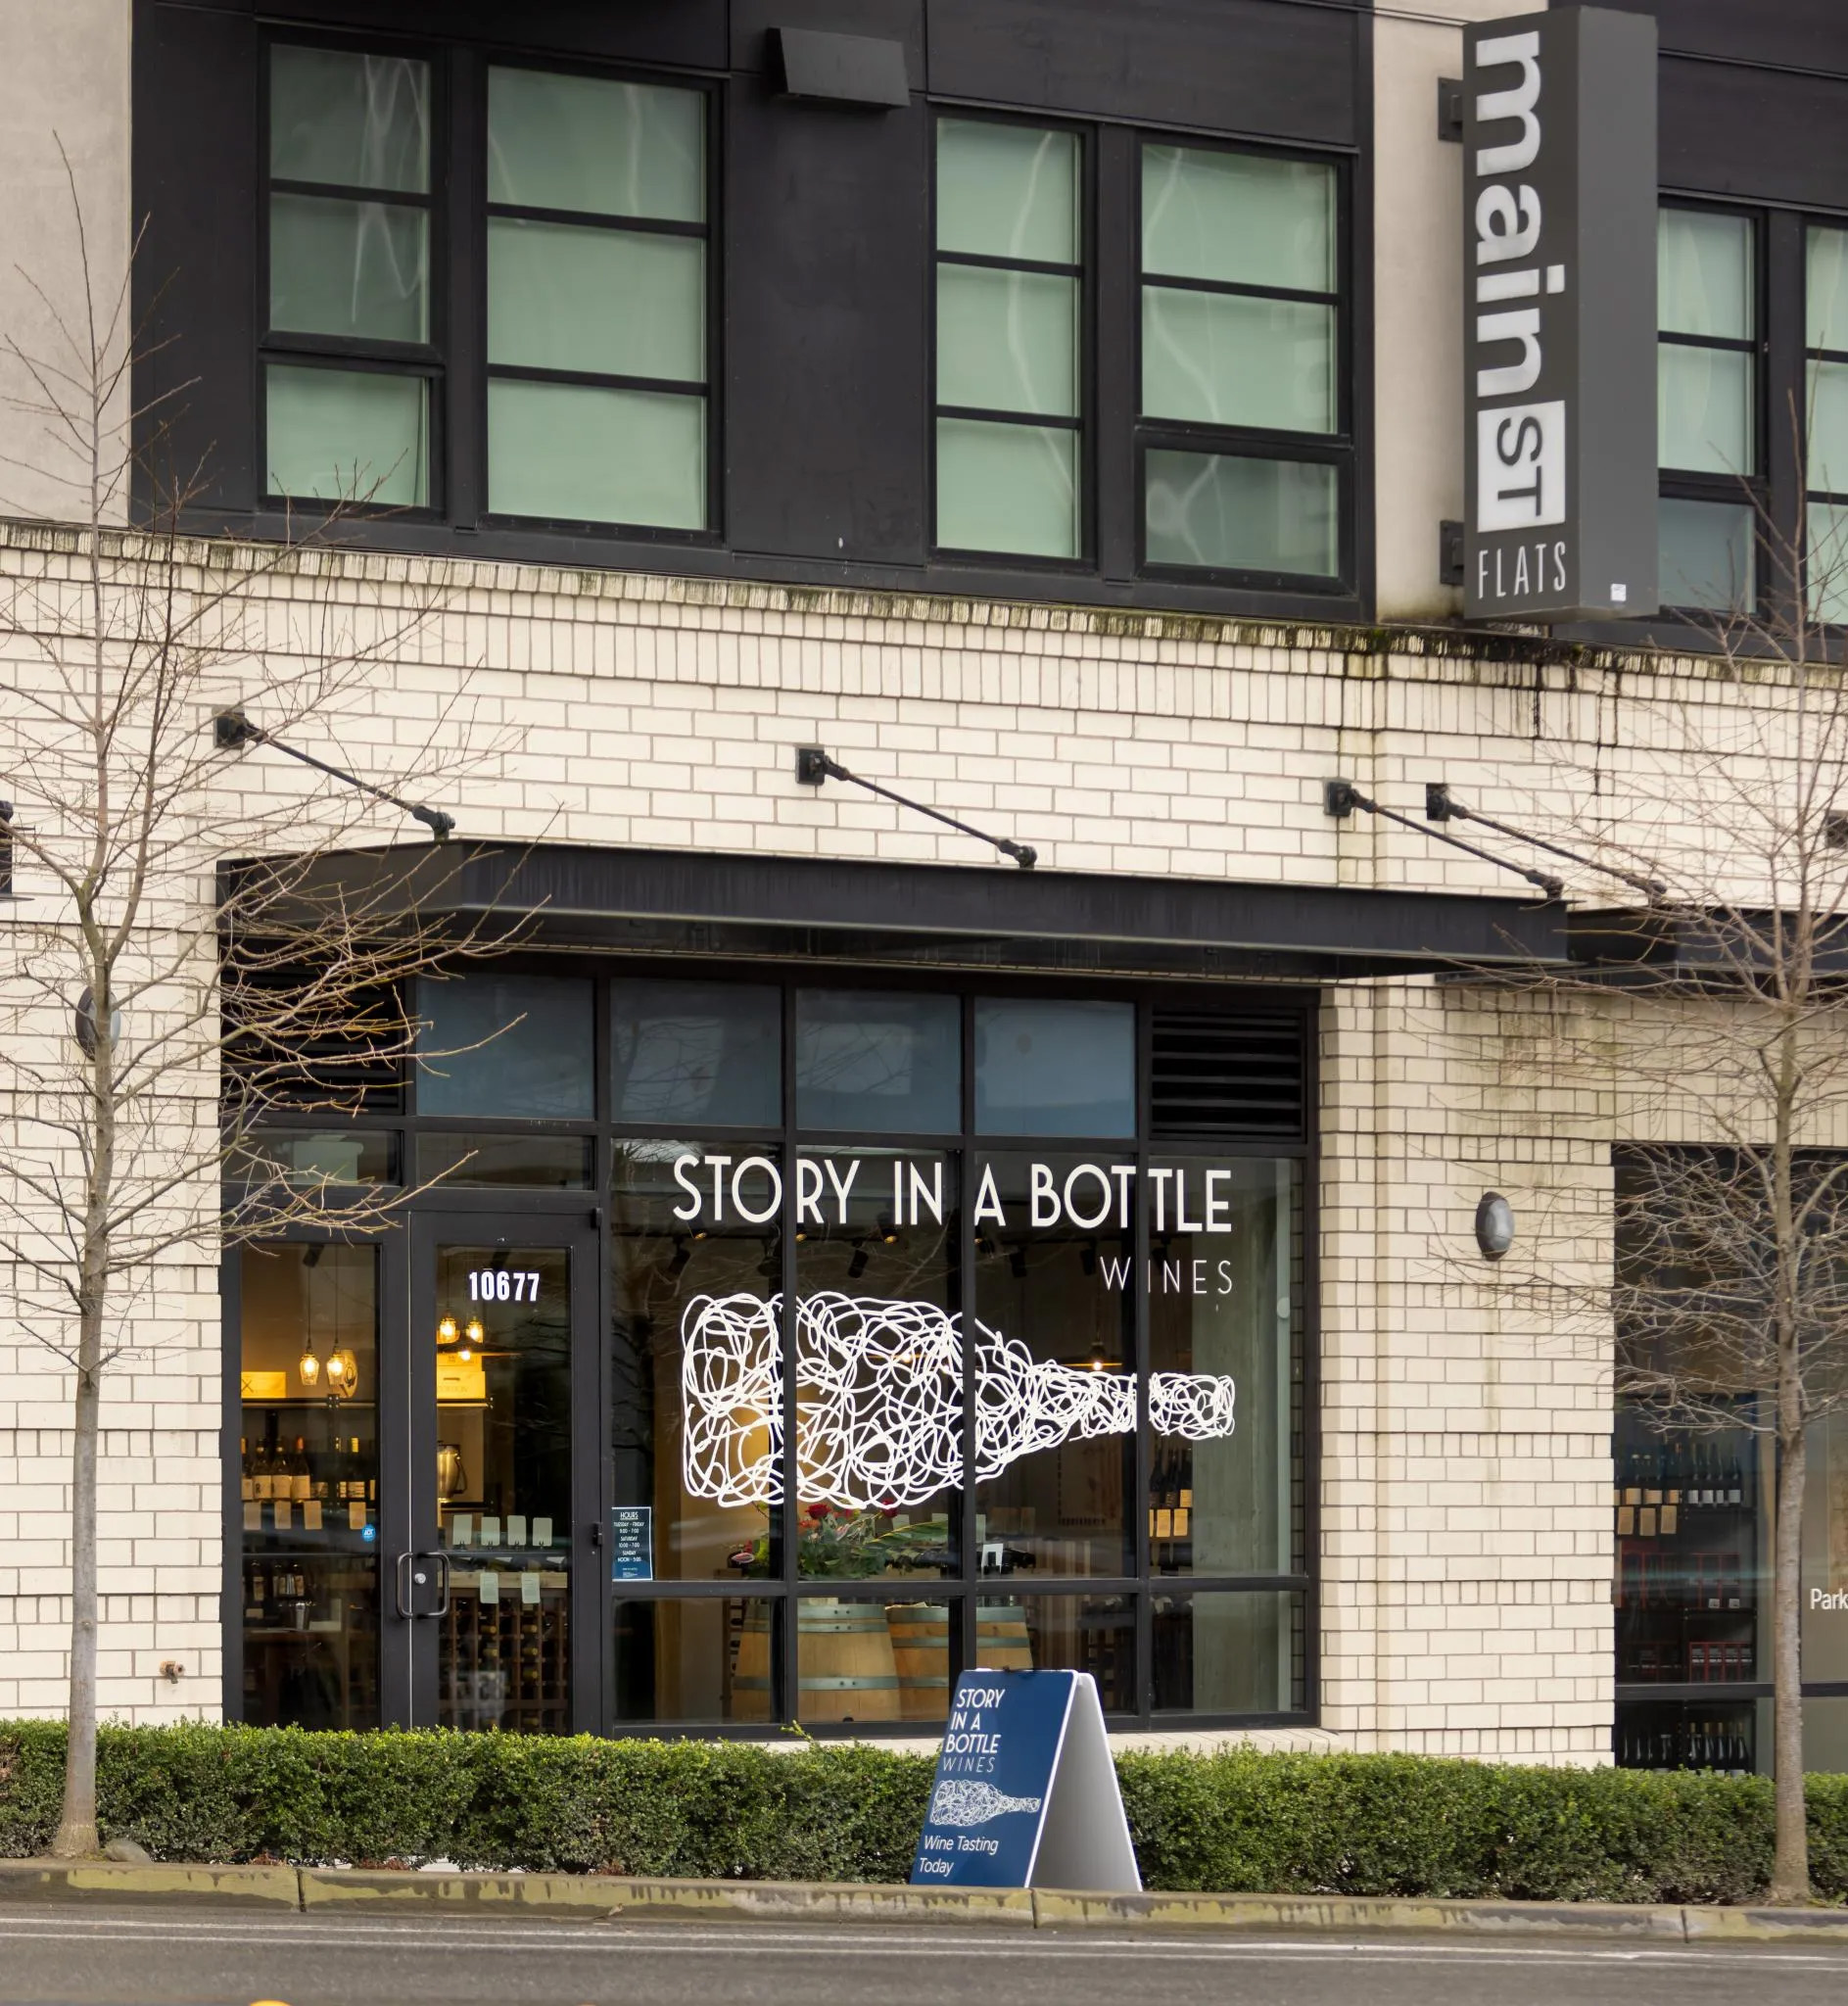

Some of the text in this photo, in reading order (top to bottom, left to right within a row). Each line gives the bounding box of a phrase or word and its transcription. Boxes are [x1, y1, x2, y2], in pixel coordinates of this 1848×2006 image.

[1477, 541, 1566, 598] FLATS
[673, 1155, 1232, 1232] STORY IN A BOTTLE
[1100, 1256, 1233, 1295] WINES
[469, 1270, 540, 1302] 10677
[957, 1689, 1005, 1707] STORY
[950, 1712, 980, 1730] IN A
[945, 1734, 1001, 1753] BOTTLE
[943, 1756, 995, 1773] WINES
[924, 1835, 999, 1855] Wine Tasting
[919, 1857, 954, 1877] Today
